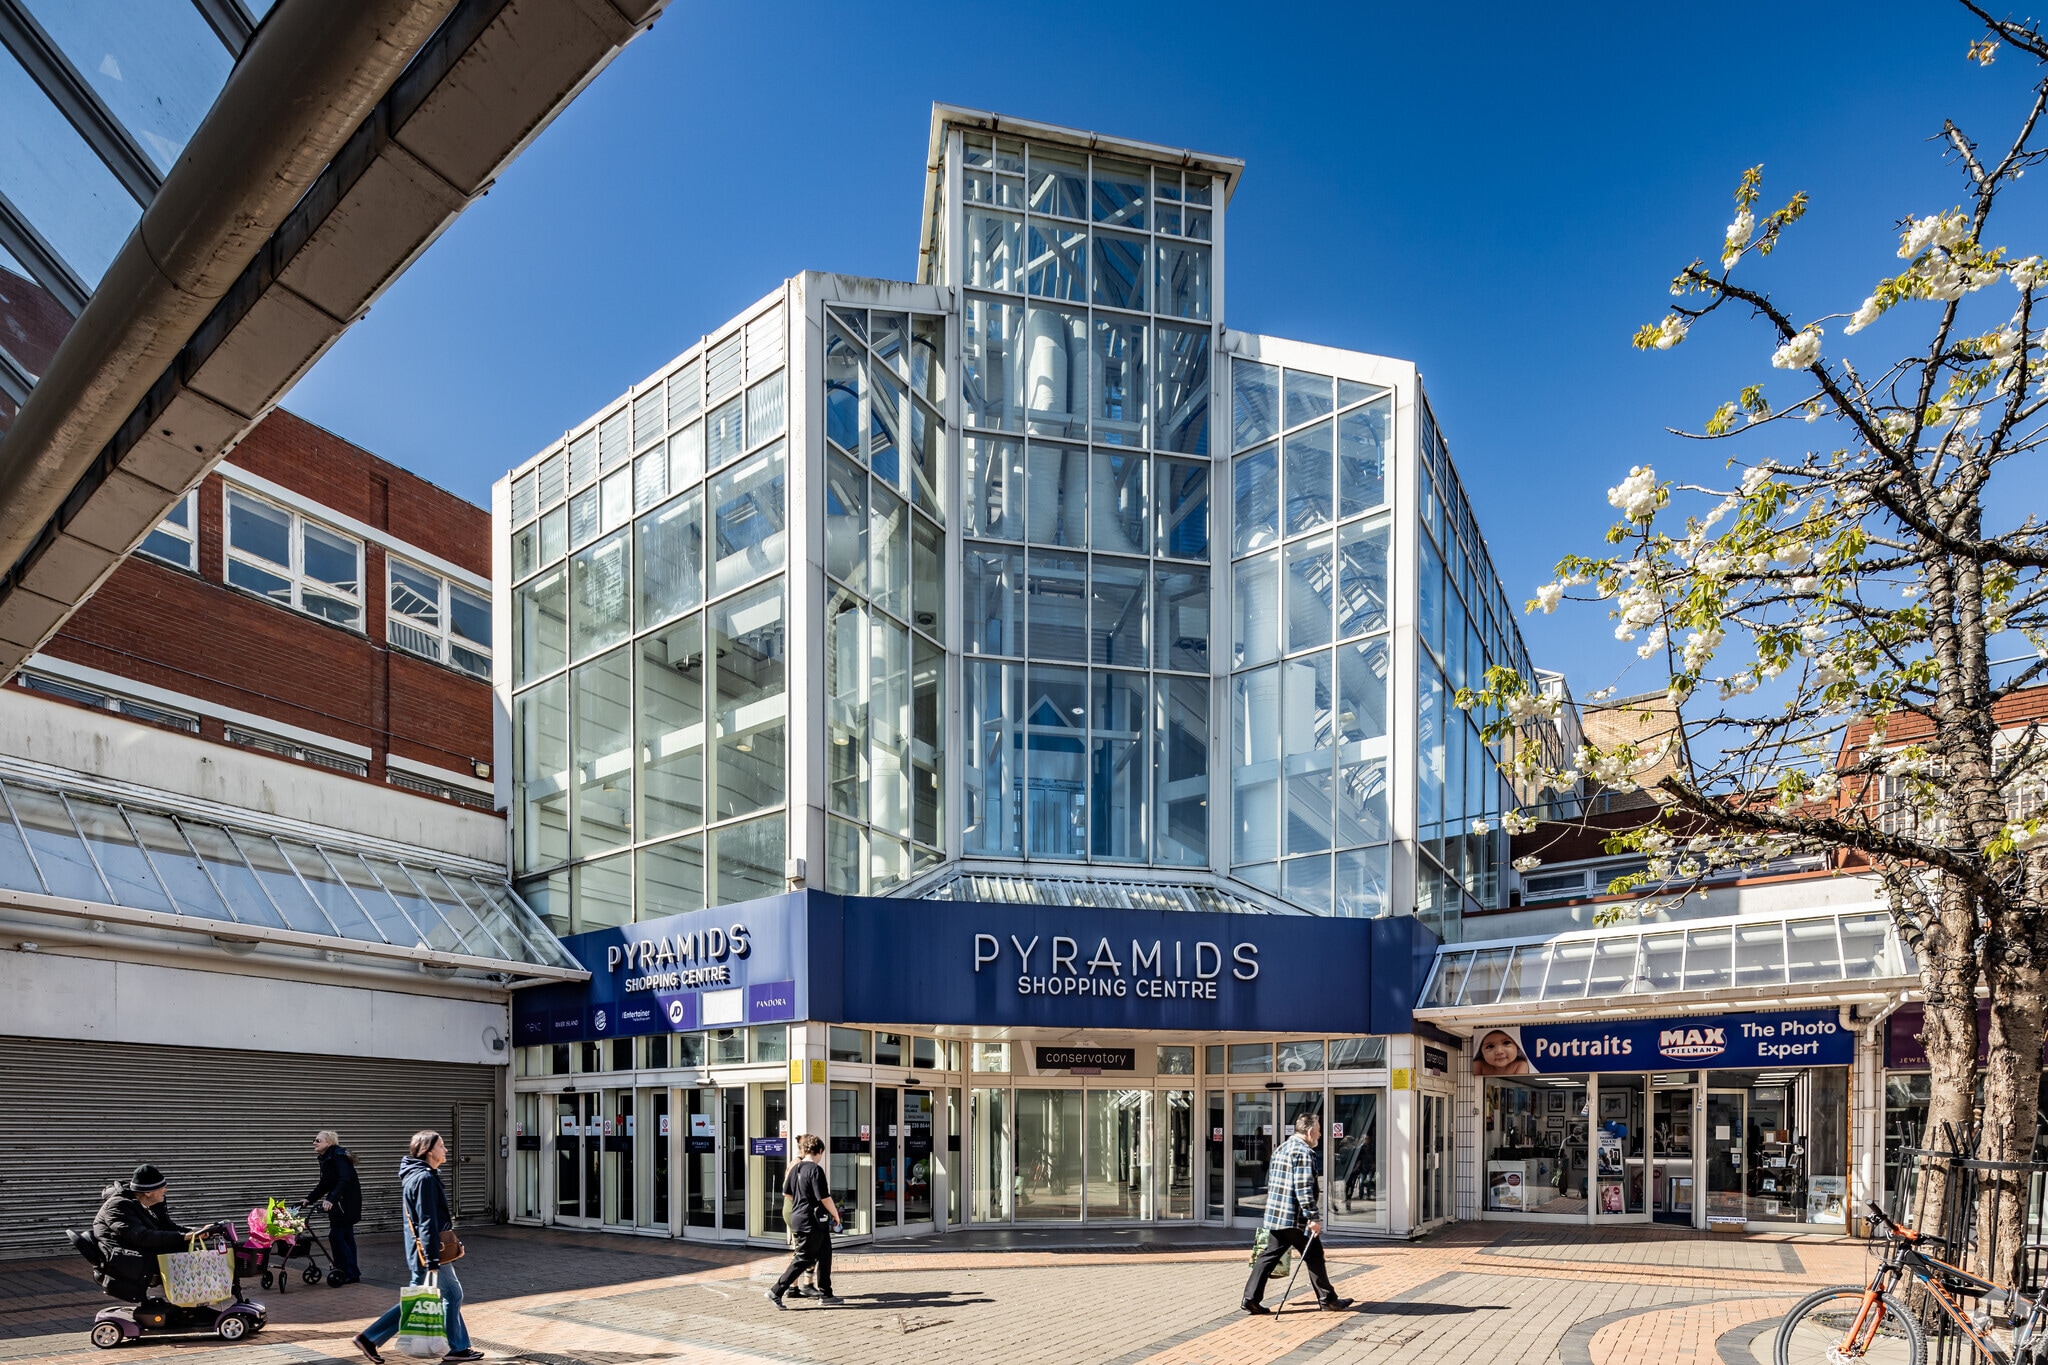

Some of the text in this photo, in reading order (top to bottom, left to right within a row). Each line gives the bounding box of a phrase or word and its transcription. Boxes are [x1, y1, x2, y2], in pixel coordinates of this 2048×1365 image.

[608, 924, 748, 972] PYRAMIDS
[975, 934, 1259, 979] PYRAMIDS
[625, 965, 727, 992] SHOPPING CENTRE
[1018, 976, 1217, 998] SHOPPING CENTRE
[756, 999, 786, 1008] PANDORA
[1660, 1028, 1725, 1047] MAX
[1741, 1020, 1837, 1038] The Photo
[1536, 1034, 1632, 1058] Portraits
[1758, 1040, 1820, 1060] Expert
[1046, 1053, 1126, 1066] conservatory
[411, 1301, 443, 1315] ASDA
